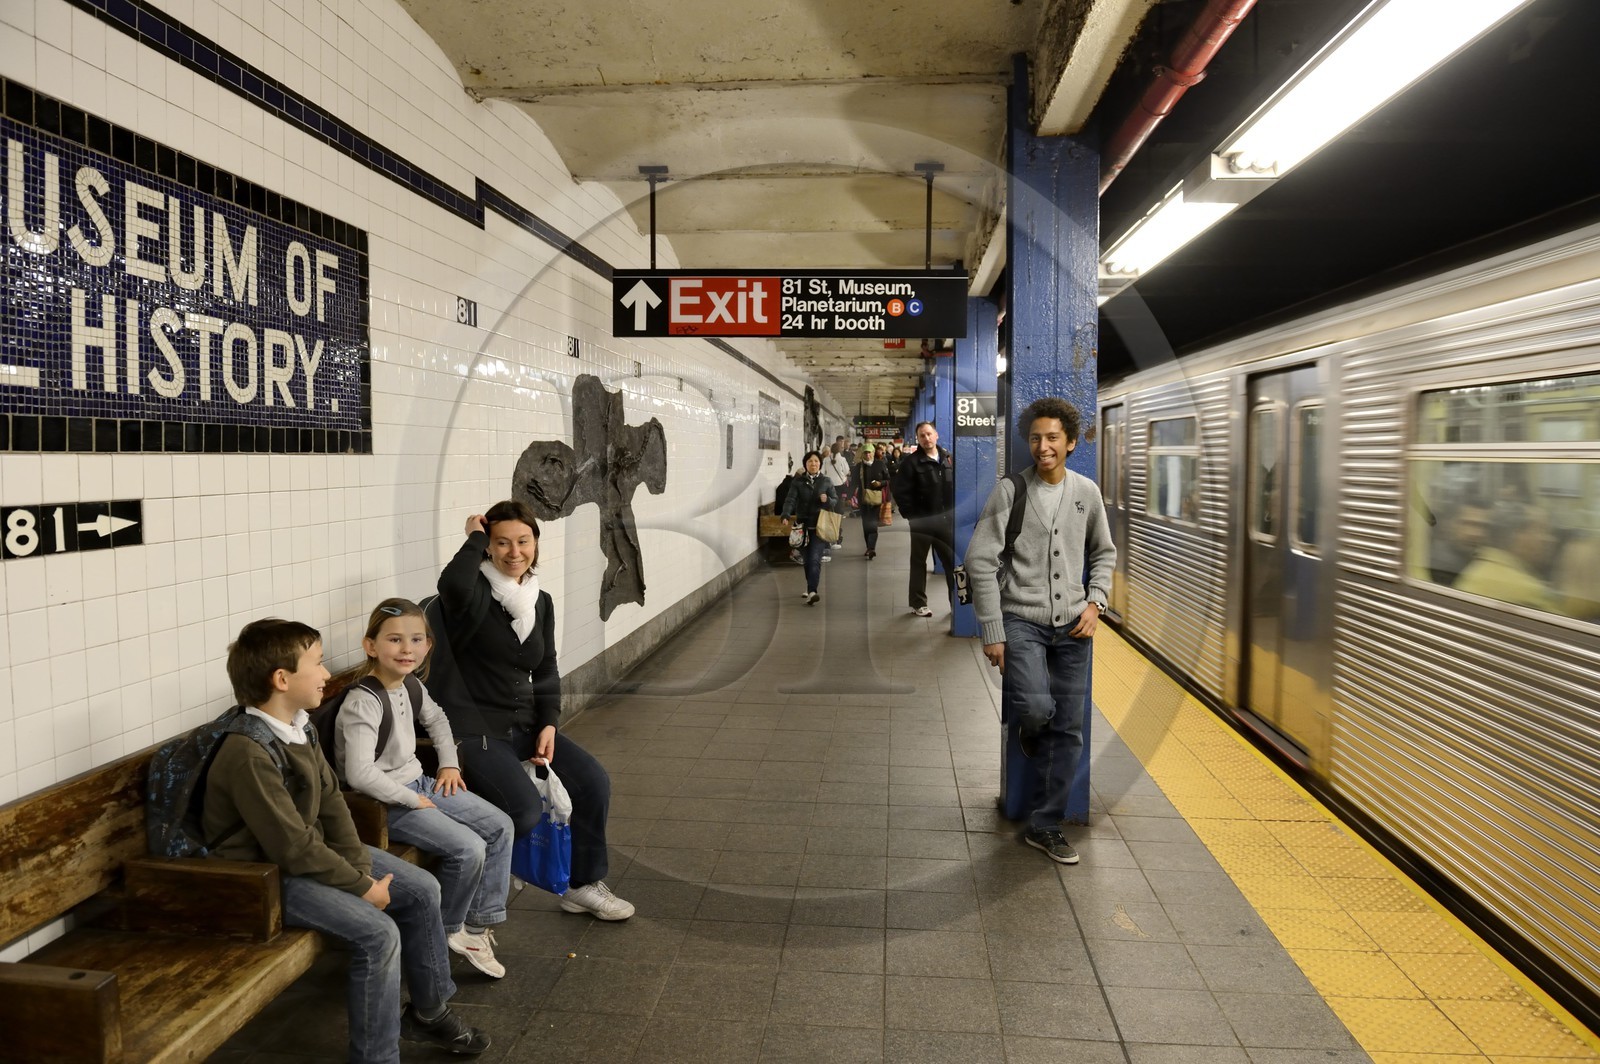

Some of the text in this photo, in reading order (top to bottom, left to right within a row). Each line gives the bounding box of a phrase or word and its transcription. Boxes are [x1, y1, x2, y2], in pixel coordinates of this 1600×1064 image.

[286, 241, 339, 322] OF
[782, 279, 915, 298] 81 St, Museum,
[671, 280, 768, 324] Exit
[782, 297, 885, 315] Planetarium,
[458, 298, 475, 326] 81
[782, 314, 885, 331] 24 hr booth
[71, 287, 339, 413] HISTORY.
[957, 398, 977, 414] 81
[957, 414, 996, 427] Street
[863, 428, 879, 436] Exit
[6, 507, 66, 557] 81
